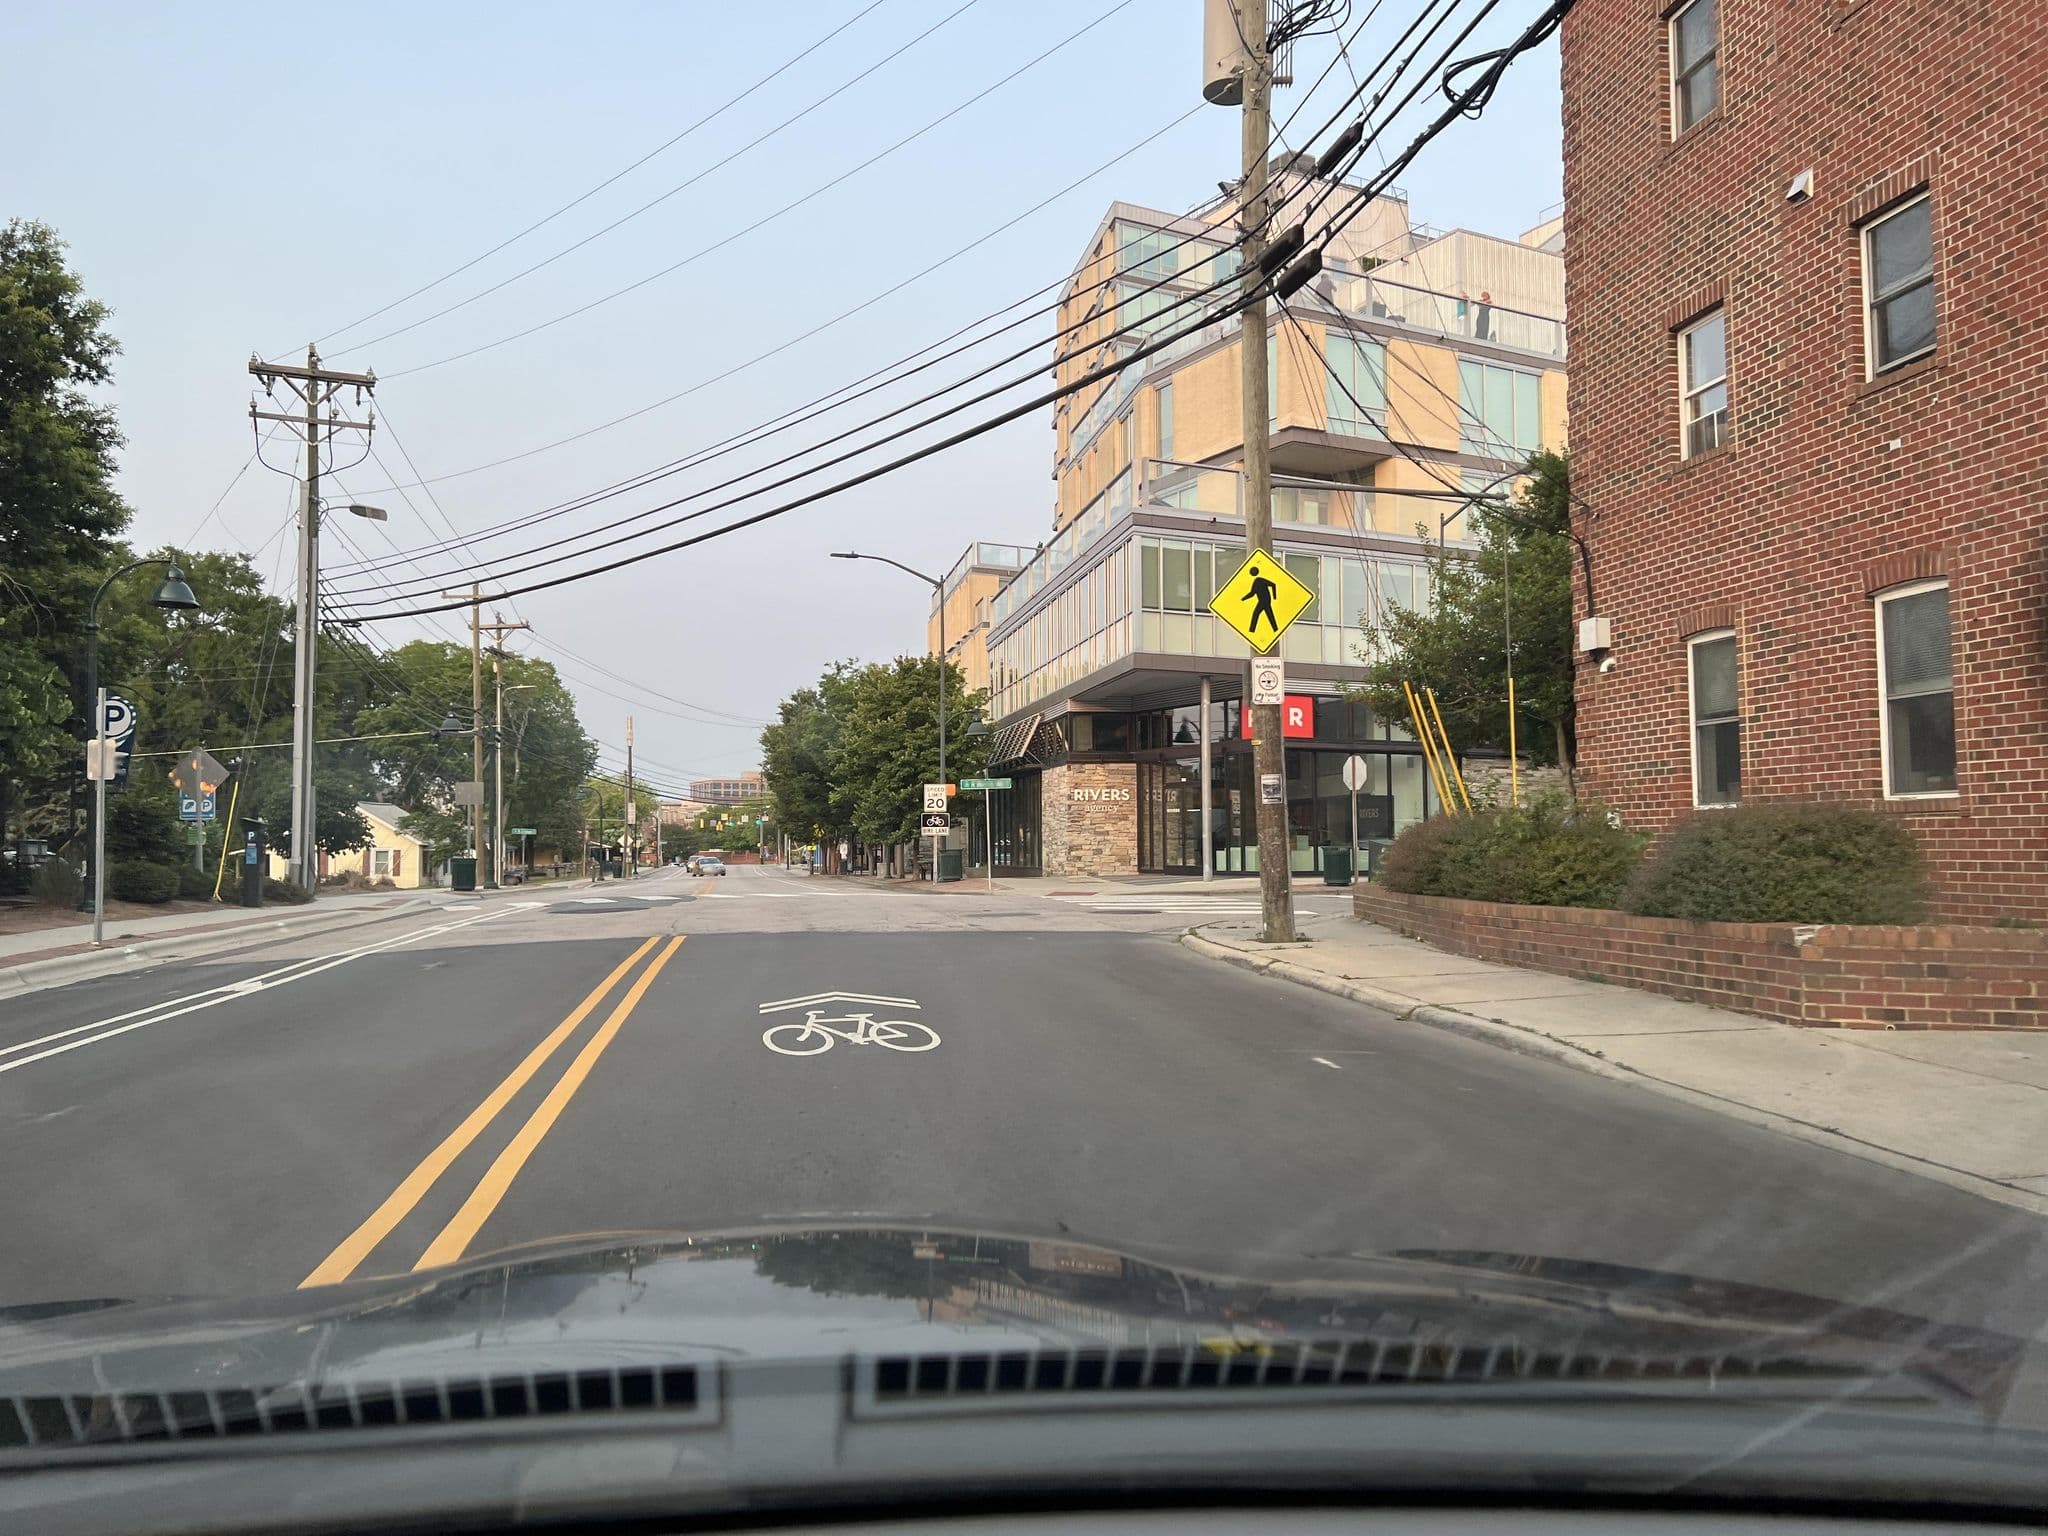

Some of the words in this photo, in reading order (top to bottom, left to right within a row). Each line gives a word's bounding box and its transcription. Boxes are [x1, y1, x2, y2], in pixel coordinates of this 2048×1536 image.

[105, 705, 124, 731] P
[1074, 788, 1130, 801] RIVERS
[927, 798, 944, 809] 20
[1085, 805, 1119, 813] agency
[248, 831, 255, 841] P
